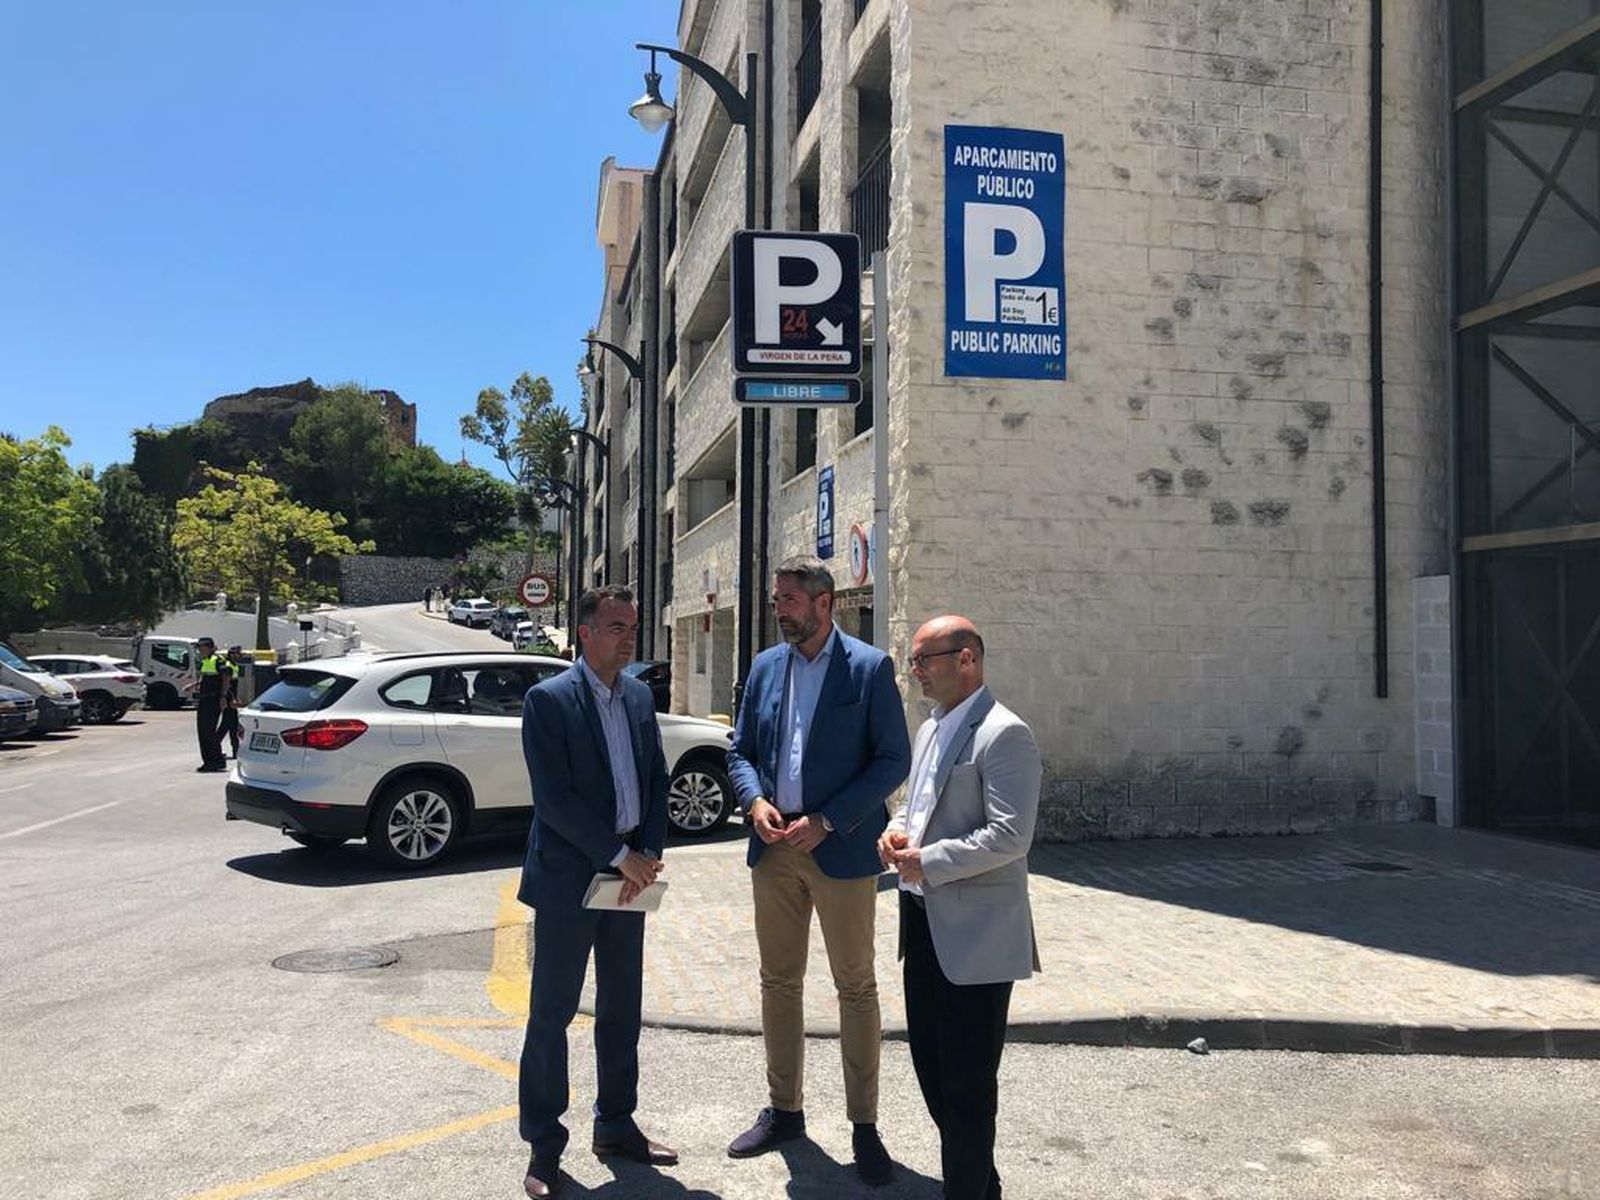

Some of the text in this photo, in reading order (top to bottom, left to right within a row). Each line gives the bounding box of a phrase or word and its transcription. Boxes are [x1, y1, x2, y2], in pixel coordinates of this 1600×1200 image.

[953, 145, 1057, 173] APARCAMIENTO
[977, 170, 1035, 199] PÚBLICO
[963, 201, 1046, 322] P
[753, 237, 843, 345] P
[782, 309, 809, 333] 24
[760, 351, 845, 362] VIRGEN DE LA PEÑA
[951, 330, 1061, 357] PUBLIC PARKING
[773, 386, 821, 398] LIBRE
